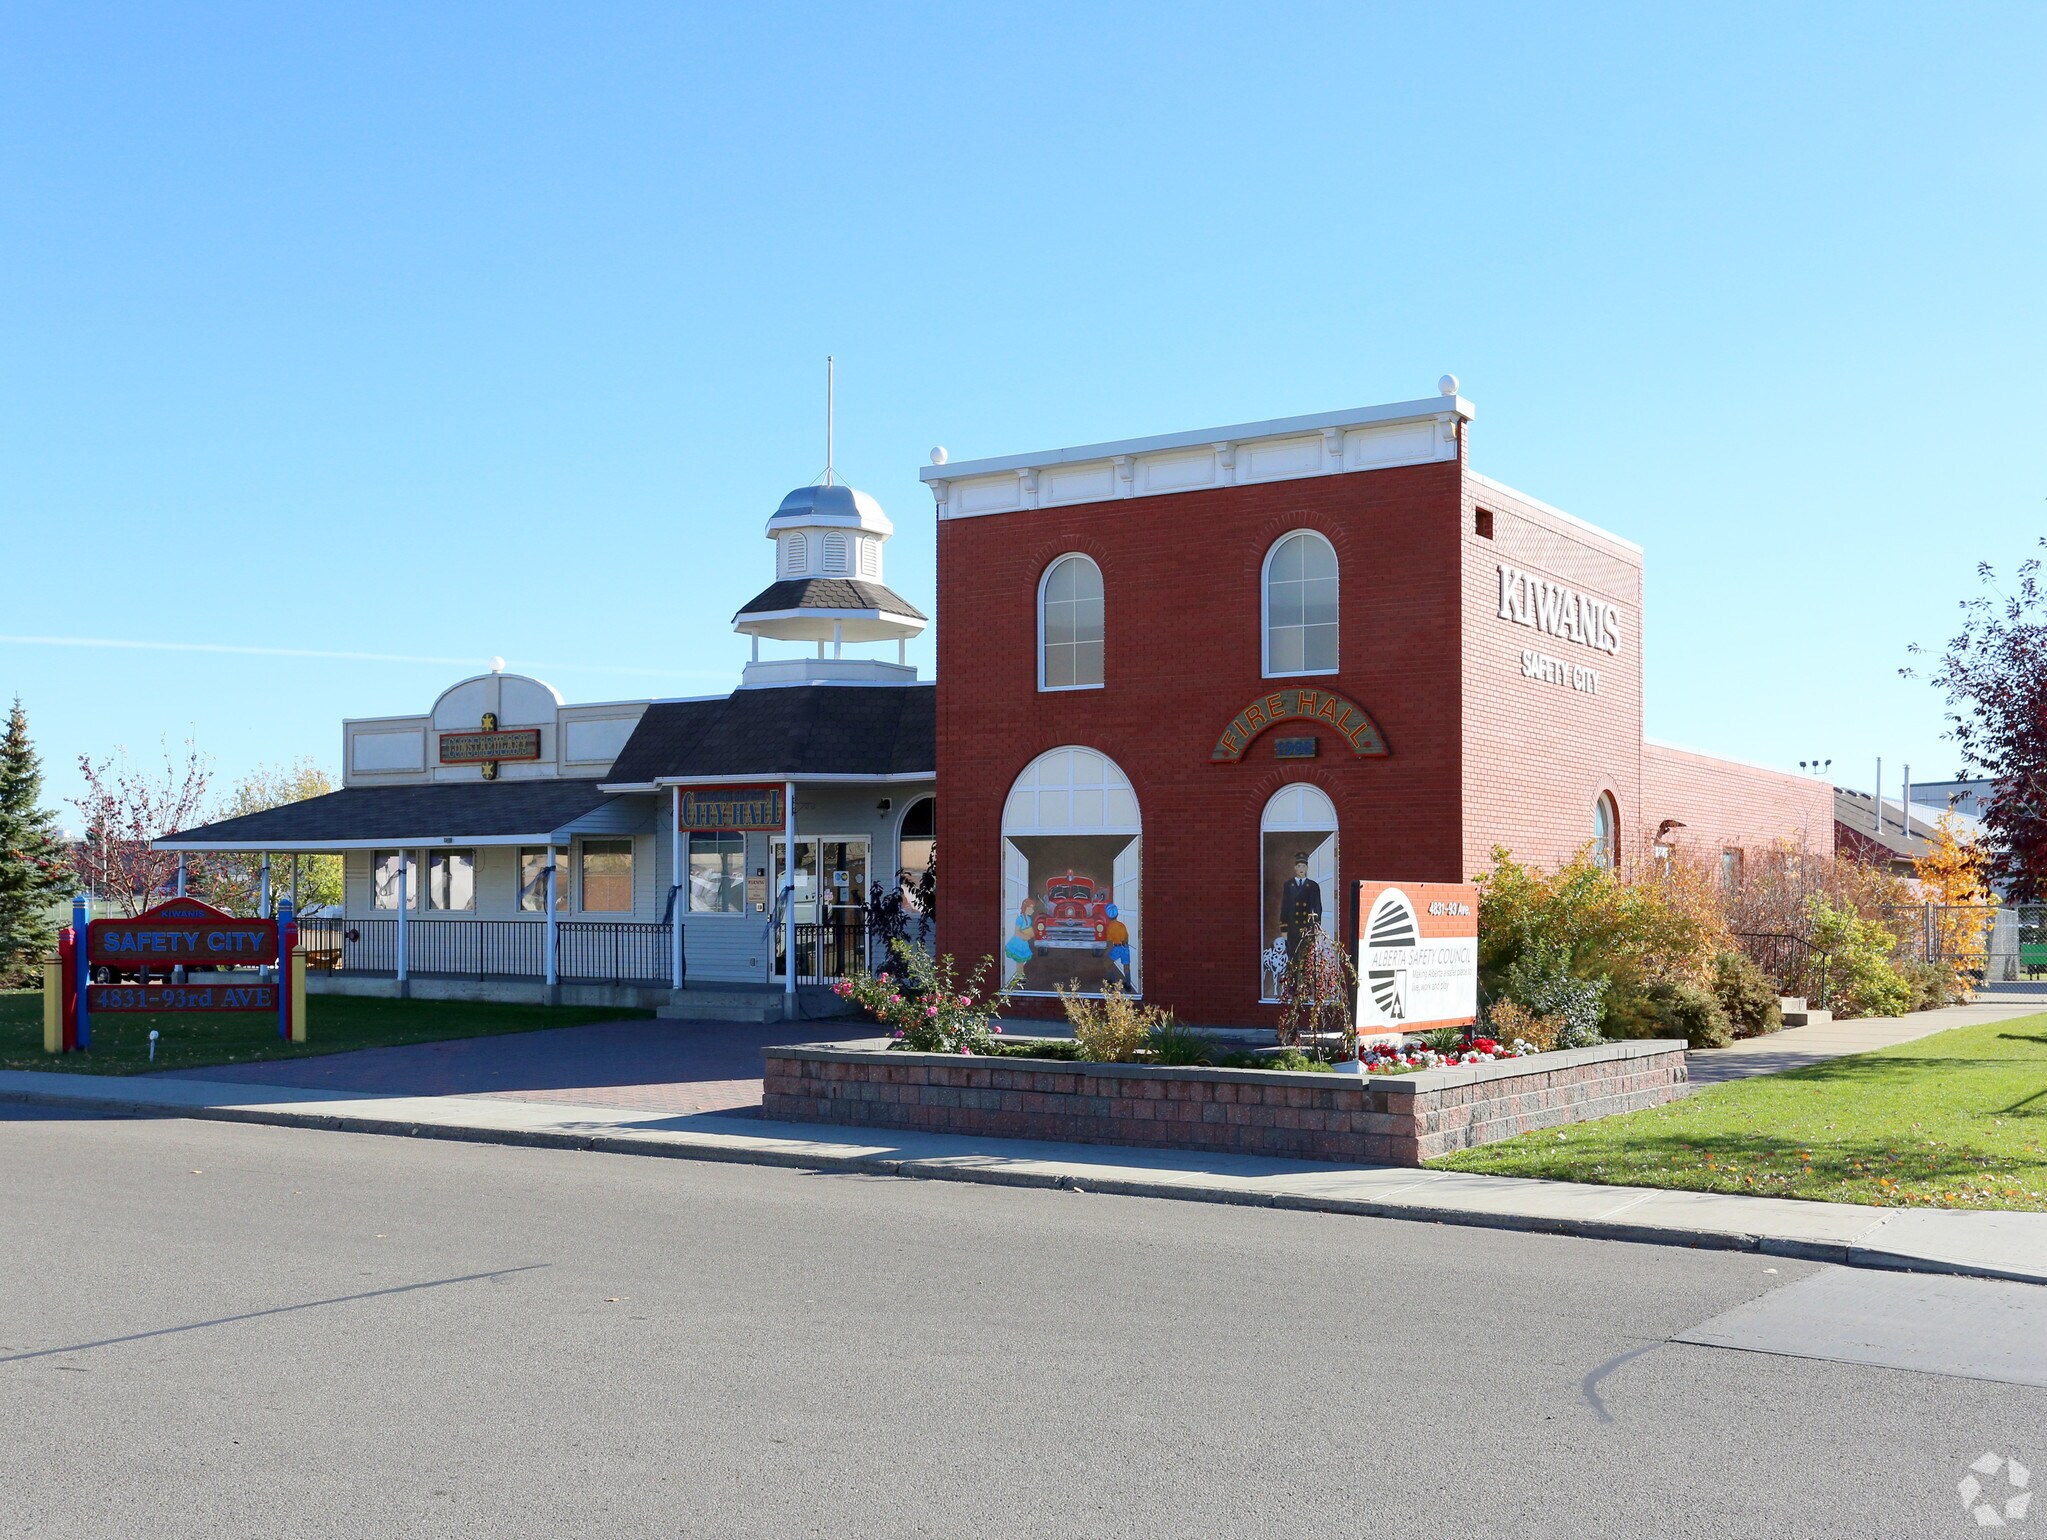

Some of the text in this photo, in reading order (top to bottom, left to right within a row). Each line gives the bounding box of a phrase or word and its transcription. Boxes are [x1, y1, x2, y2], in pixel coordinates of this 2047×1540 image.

[1497, 565, 1620, 656] KIWANIS
[1521, 650, 1599, 694] SAFETY CITY
[1221, 690, 1368, 754] FIRE HALL
[682, 789, 782, 827] CITY HALL
[161, 910, 205, 918] KIWANIS
[104, 932, 264, 951] SAFETY CITY
[1372, 947, 1471, 967] ALBERTA SAFETY COUNCIL
[222, 988, 272, 1007] AVE
